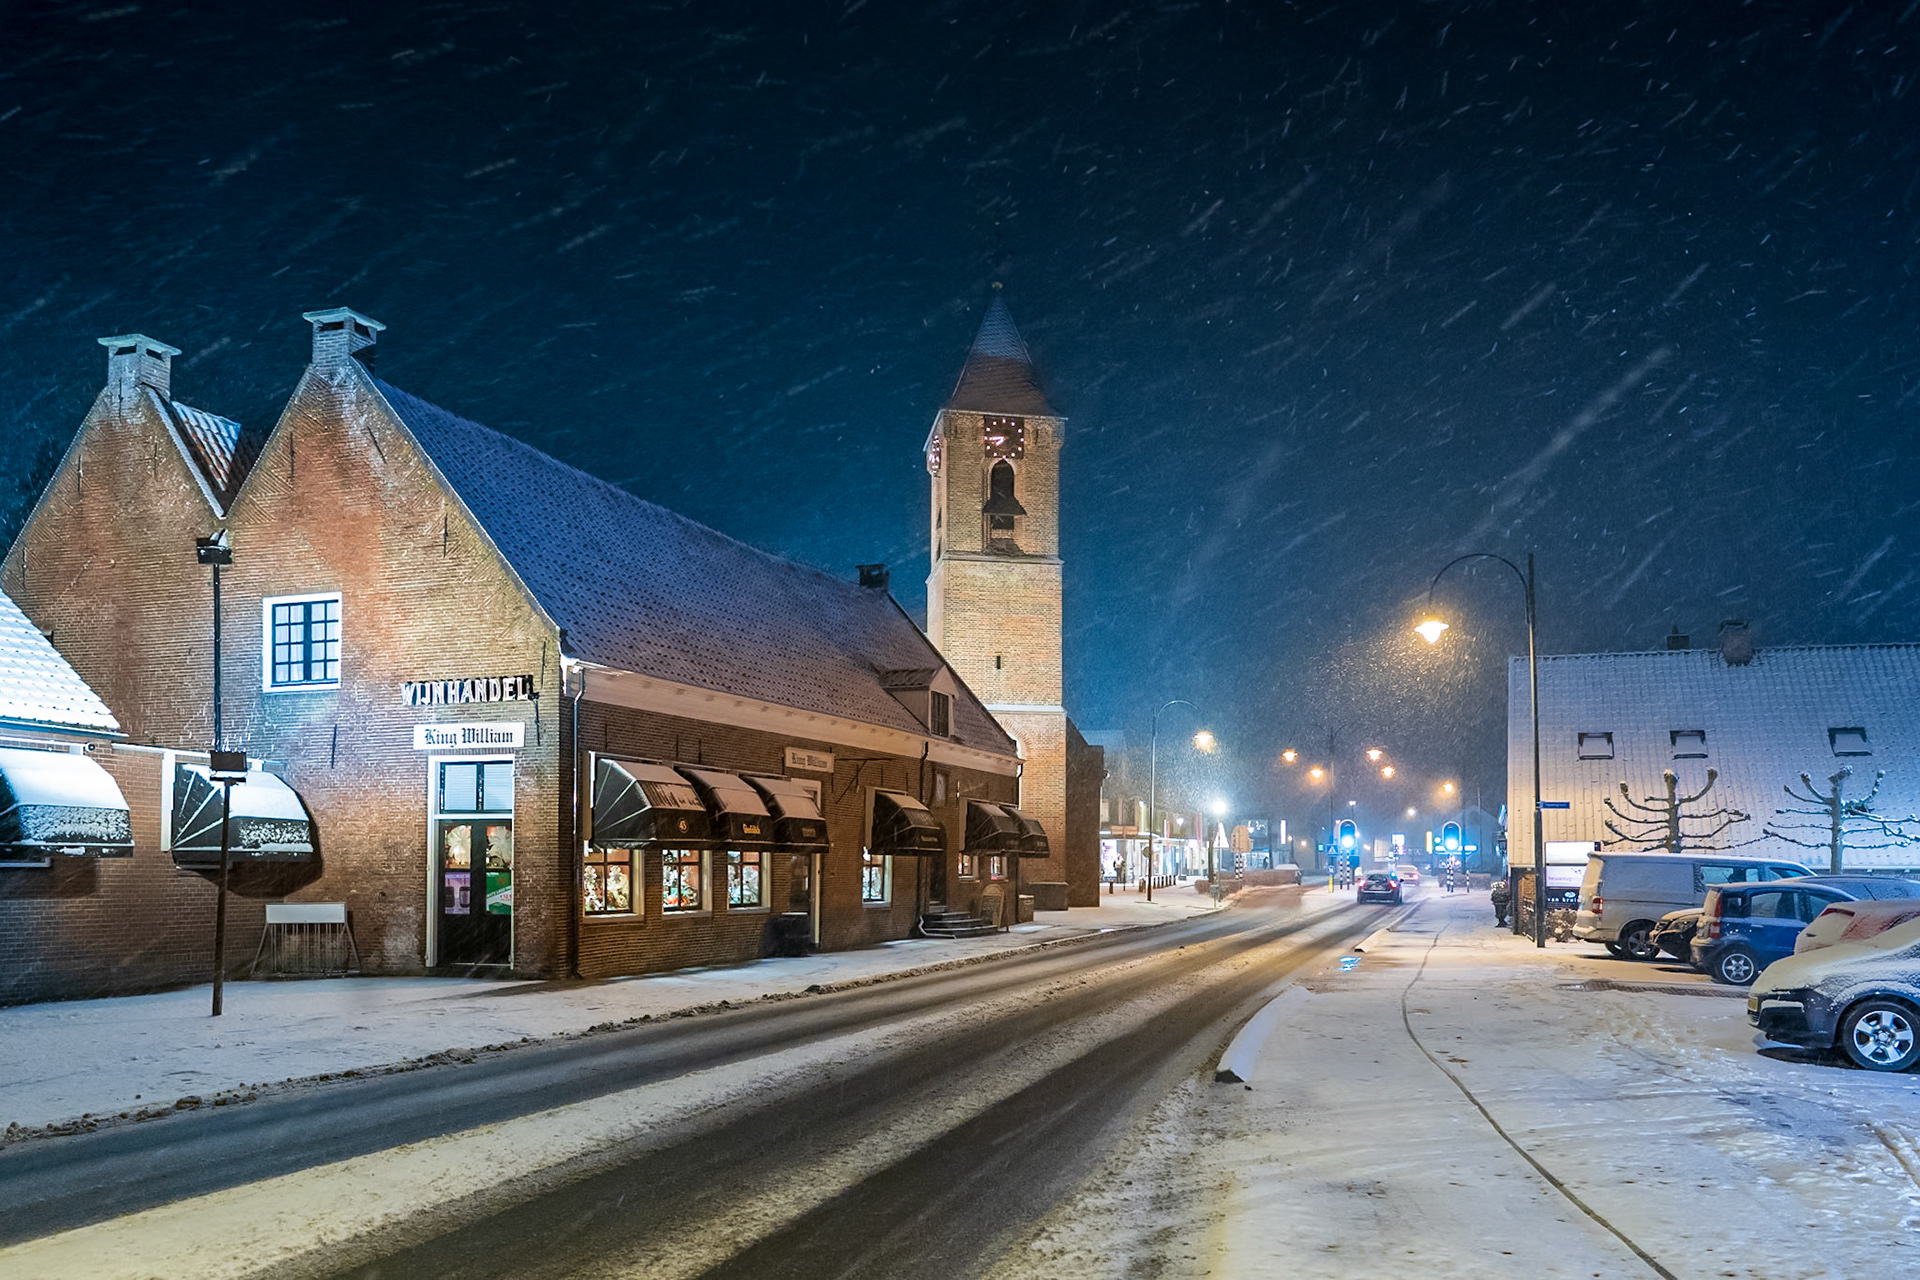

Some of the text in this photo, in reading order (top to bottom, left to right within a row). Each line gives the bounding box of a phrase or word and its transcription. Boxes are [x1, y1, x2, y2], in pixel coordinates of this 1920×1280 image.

[400, 676, 531, 706] WIJNHANDEL
[424, 727, 514, 748] King William
